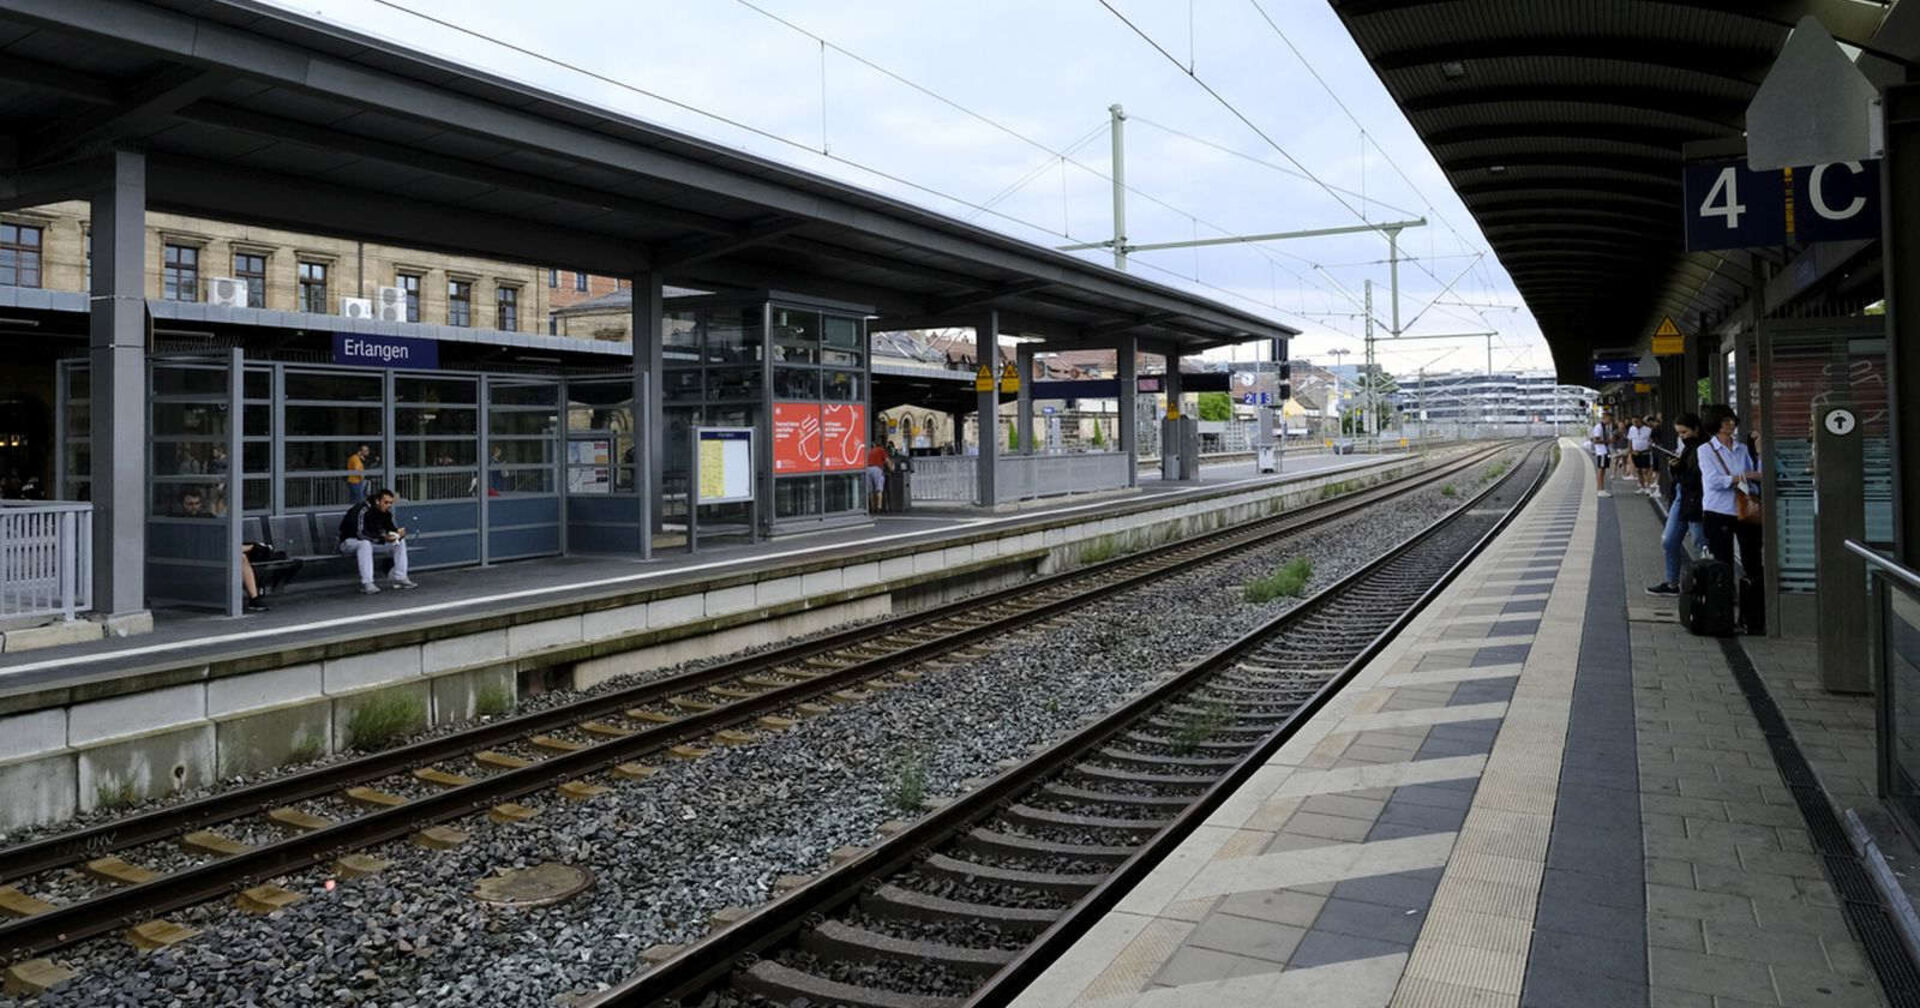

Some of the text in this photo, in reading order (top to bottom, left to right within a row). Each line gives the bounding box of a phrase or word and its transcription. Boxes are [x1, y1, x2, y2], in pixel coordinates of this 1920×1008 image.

[1700, 161, 1867, 229] 4 C
[344, 339, 409, 361] Erlangen
[1245, 393, 1253, 403] 2
